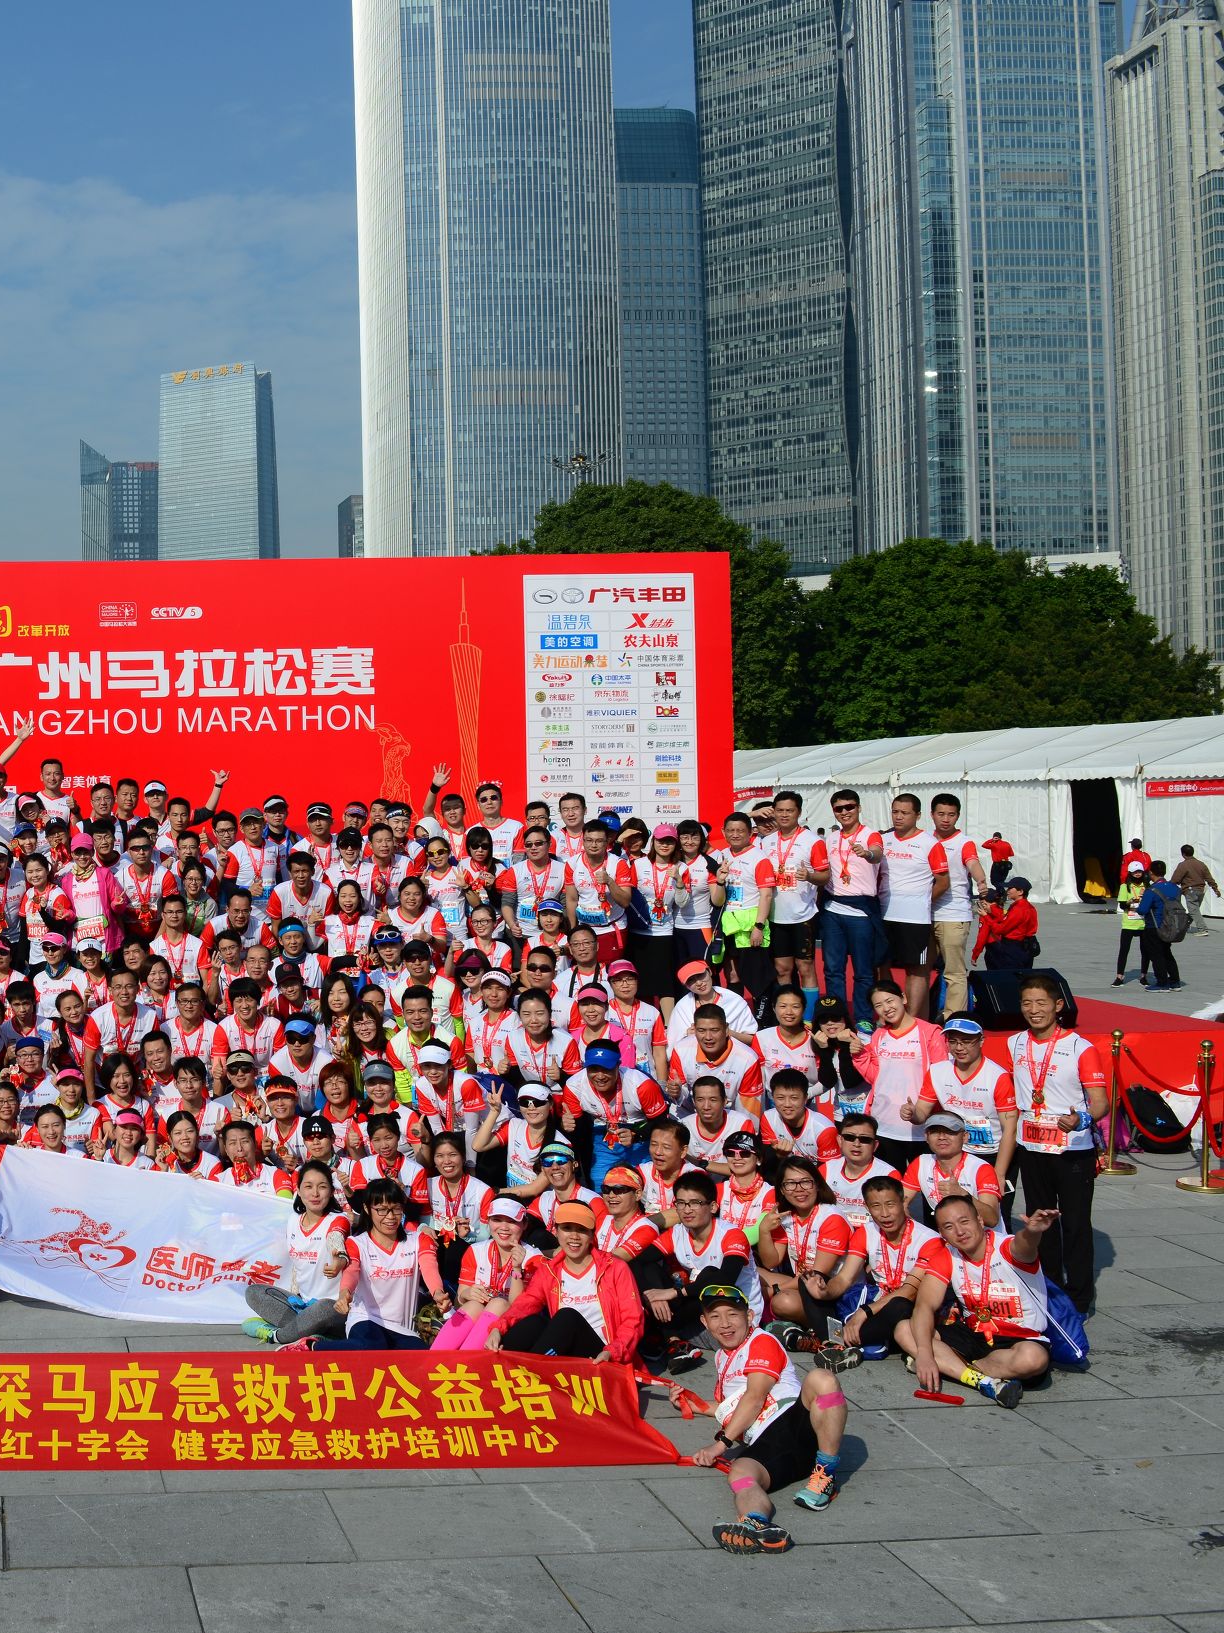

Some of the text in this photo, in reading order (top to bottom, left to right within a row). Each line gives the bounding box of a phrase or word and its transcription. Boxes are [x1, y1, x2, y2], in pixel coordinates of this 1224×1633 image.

[588, 587, 686, 603] 广汽丰田
[548, 614, 592, 630] 温碧泉
[18, 625, 70, 637] 改革开放
[545, 636, 594, 648] 美的空调
[624, 634, 678, 648] 农夫山泉
[637, 654, 684, 662] 中国体育彩票
[594, 690, 628, 698] 京东物流
[656, 706, 679, 715] Dole
[178, 704, 375, 733] MARATHON
[544, 756, 570, 767] horizon
[141, 1273, 205, 1292] Doctor
[171, 1425, 560, 1463] 健安应急救护培训中心
